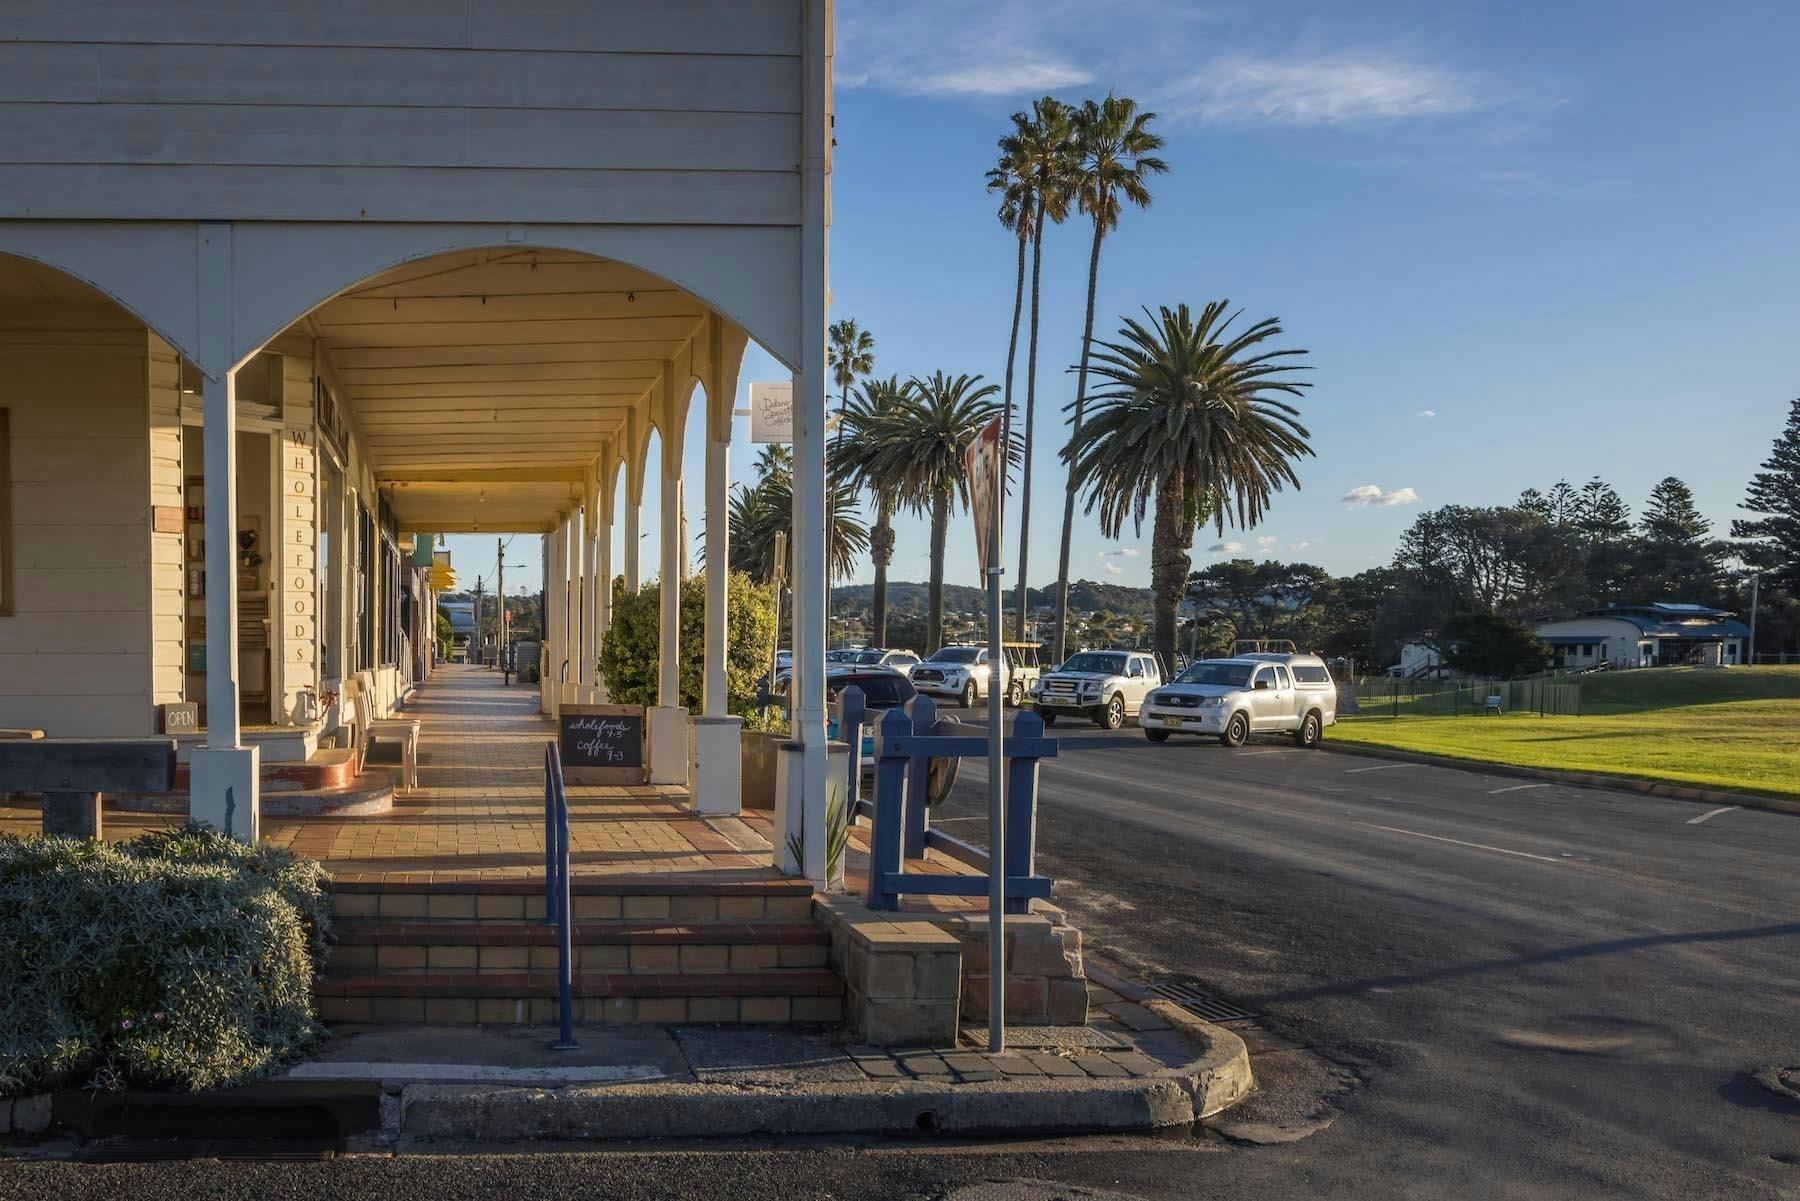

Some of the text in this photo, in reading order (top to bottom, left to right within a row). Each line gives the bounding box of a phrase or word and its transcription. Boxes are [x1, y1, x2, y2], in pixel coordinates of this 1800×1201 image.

[292, 431, 306, 661] WHOLEFOODS
[168, 711, 194, 726] OPEN
[569, 719, 631, 737] wholefoods
